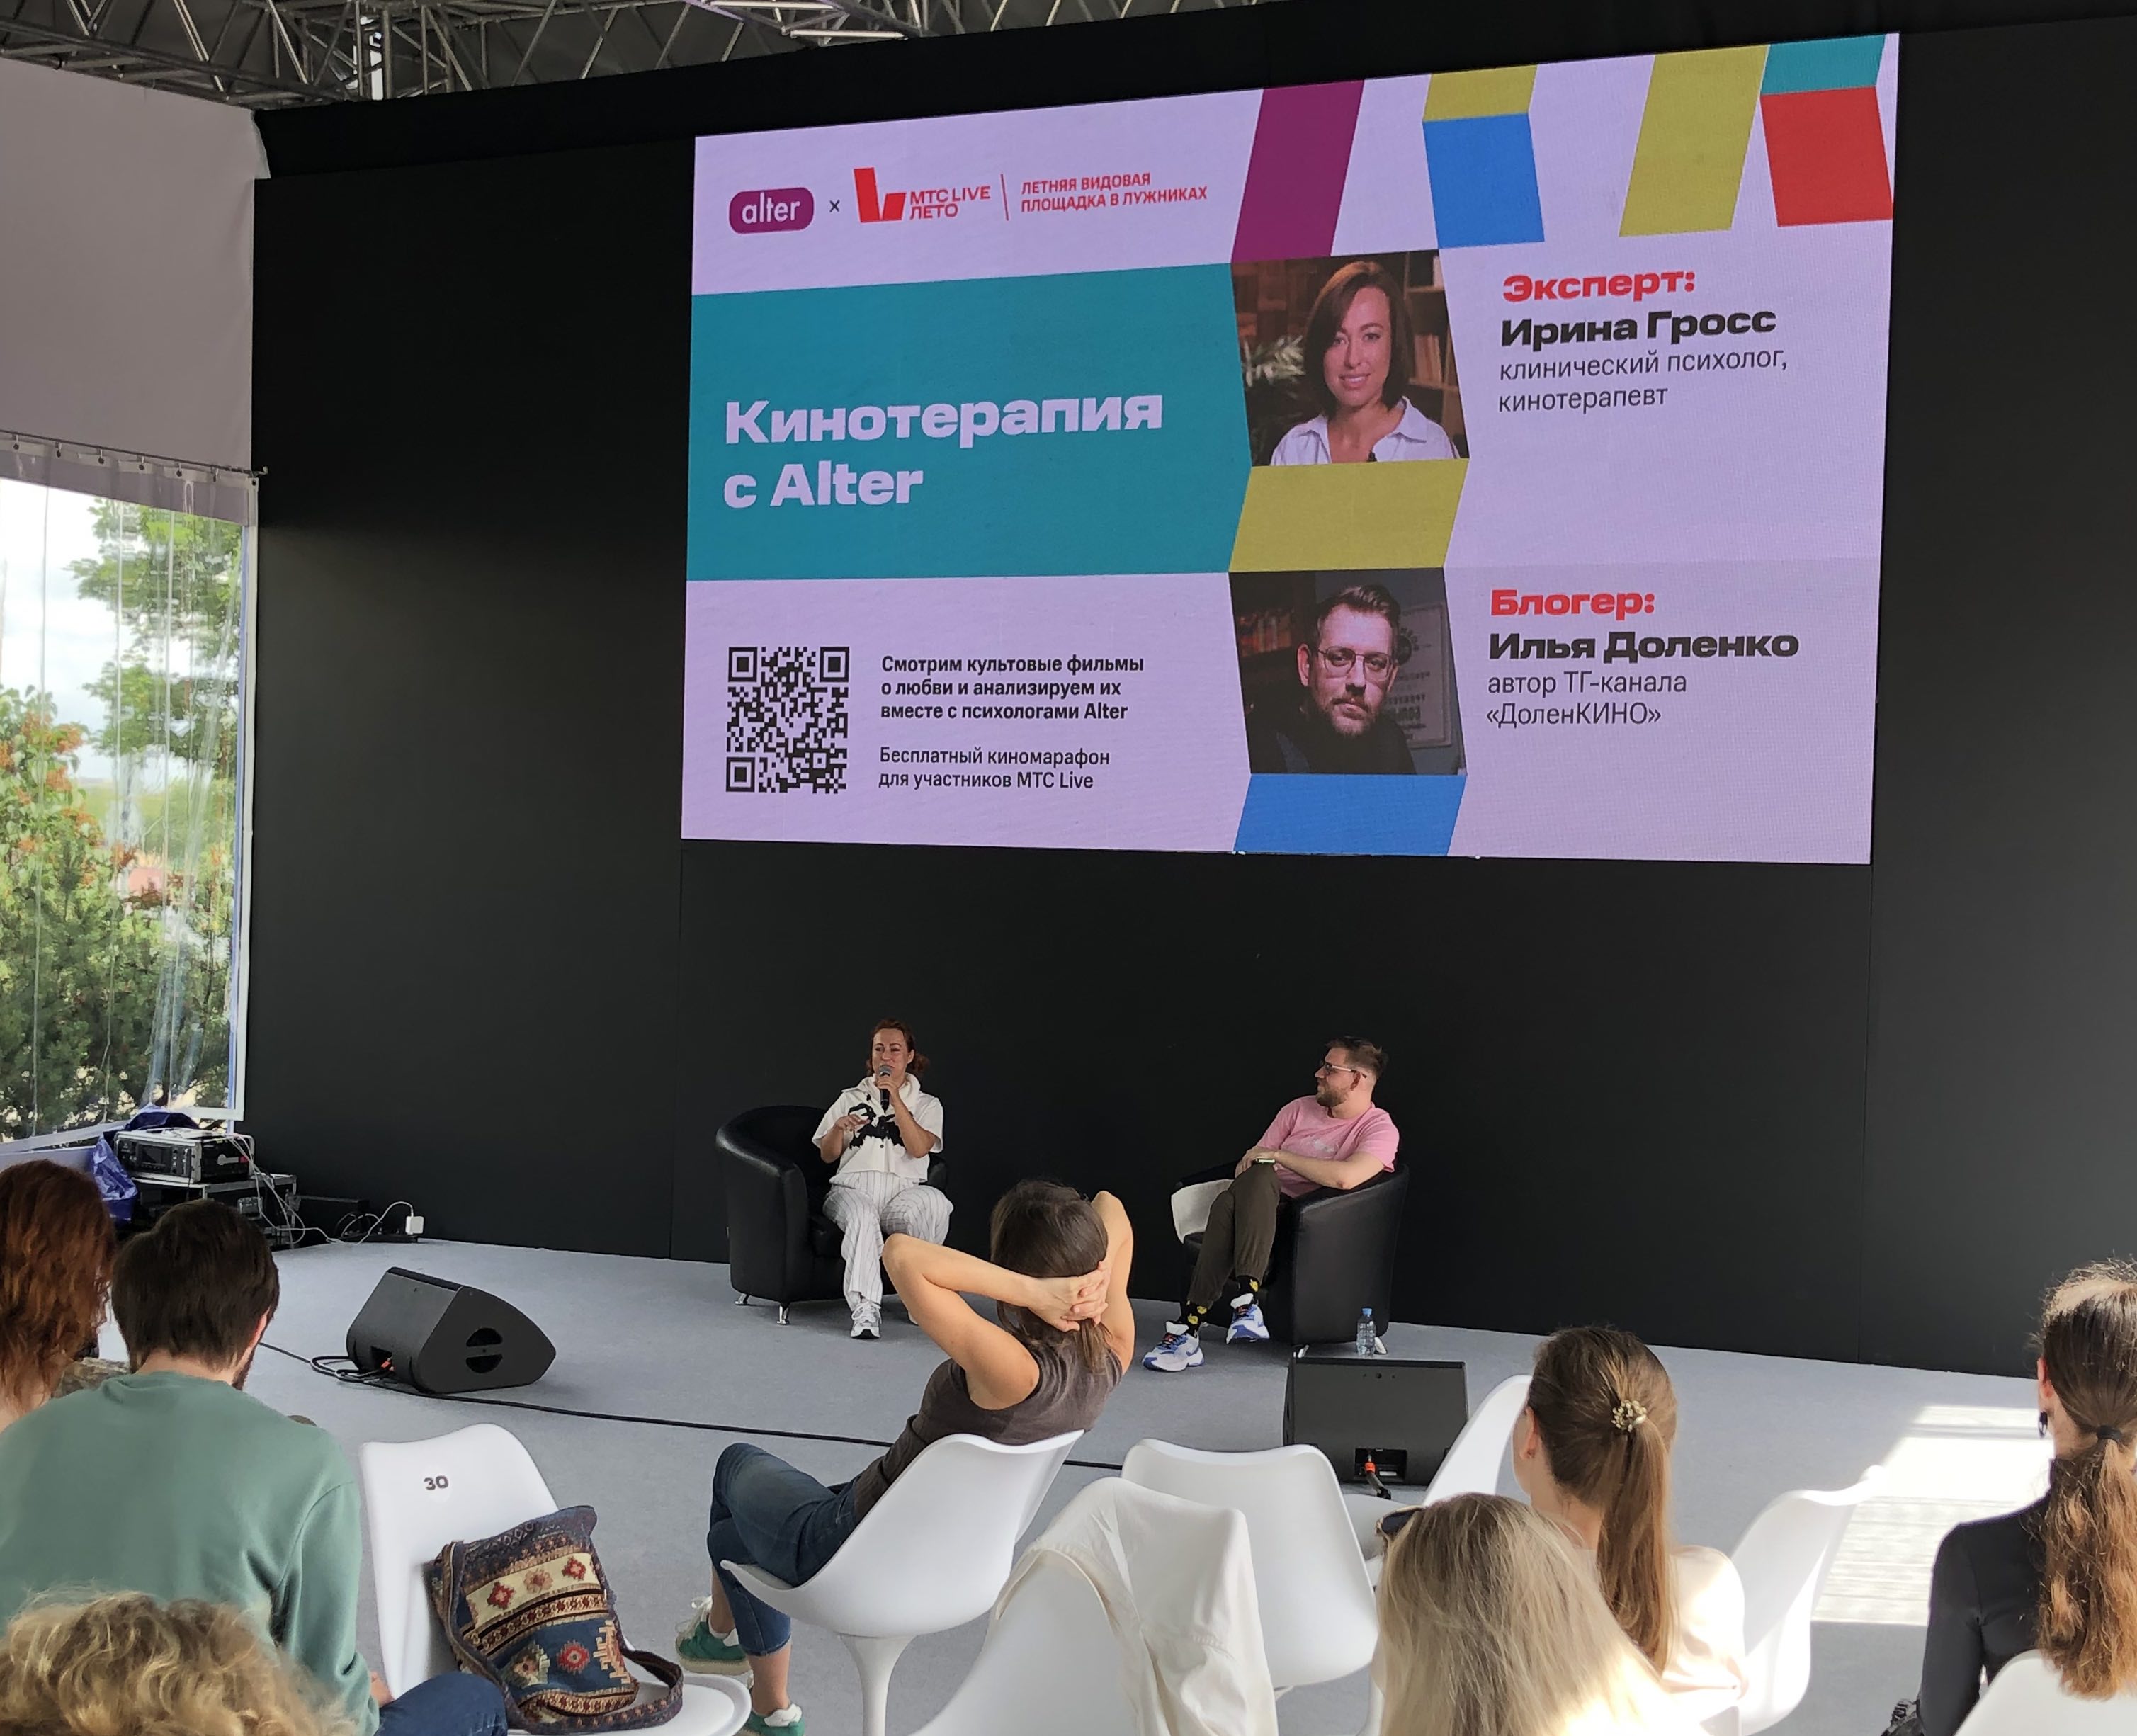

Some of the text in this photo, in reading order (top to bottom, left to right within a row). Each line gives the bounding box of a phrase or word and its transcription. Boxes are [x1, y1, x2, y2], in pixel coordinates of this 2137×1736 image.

[951, 186, 991, 203] LIVE
[1021, 172, 1150, 195] ЛЕТНЯЯ ВИДОВАЯ
[741, 191, 801, 225] alter
[909, 203, 958, 220] ЛЕТО
[1021, 186, 1208, 212] ПЛОЩАДКА В ЛУЖНИКАХ
[1503, 271, 1696, 302] Эксперт:
[1501, 310, 1776, 353] Ирина Гросс
[1500, 349, 1787, 380] клинический психолог,
[1499, 387, 1668, 414] кинотерапевт
[726, 395, 1162, 448] Кинотерапия
[724, 460, 924, 509] с Alter
[1490, 589, 1655, 621] Блогер:
[1489, 631, 1799, 664] Илья Доленко
[882, 654, 1144, 676] Смотрим культовые фильмы
[881, 678, 1121, 700] о любви и анализируем их
[1488, 670, 1687, 698] автор ТГ-канала
[880, 702, 1128, 720] вместе с психологами Alter
[1486, 701, 1662, 729] «ДоленКИНО»
[880, 746, 1110, 769] Бесплатный киномарафон
[878, 773, 909, 788] для
[913, 773, 1012, 790] участников
[1060, 771, 1094, 789] Live
[424, 1475, 449, 1491] 30
